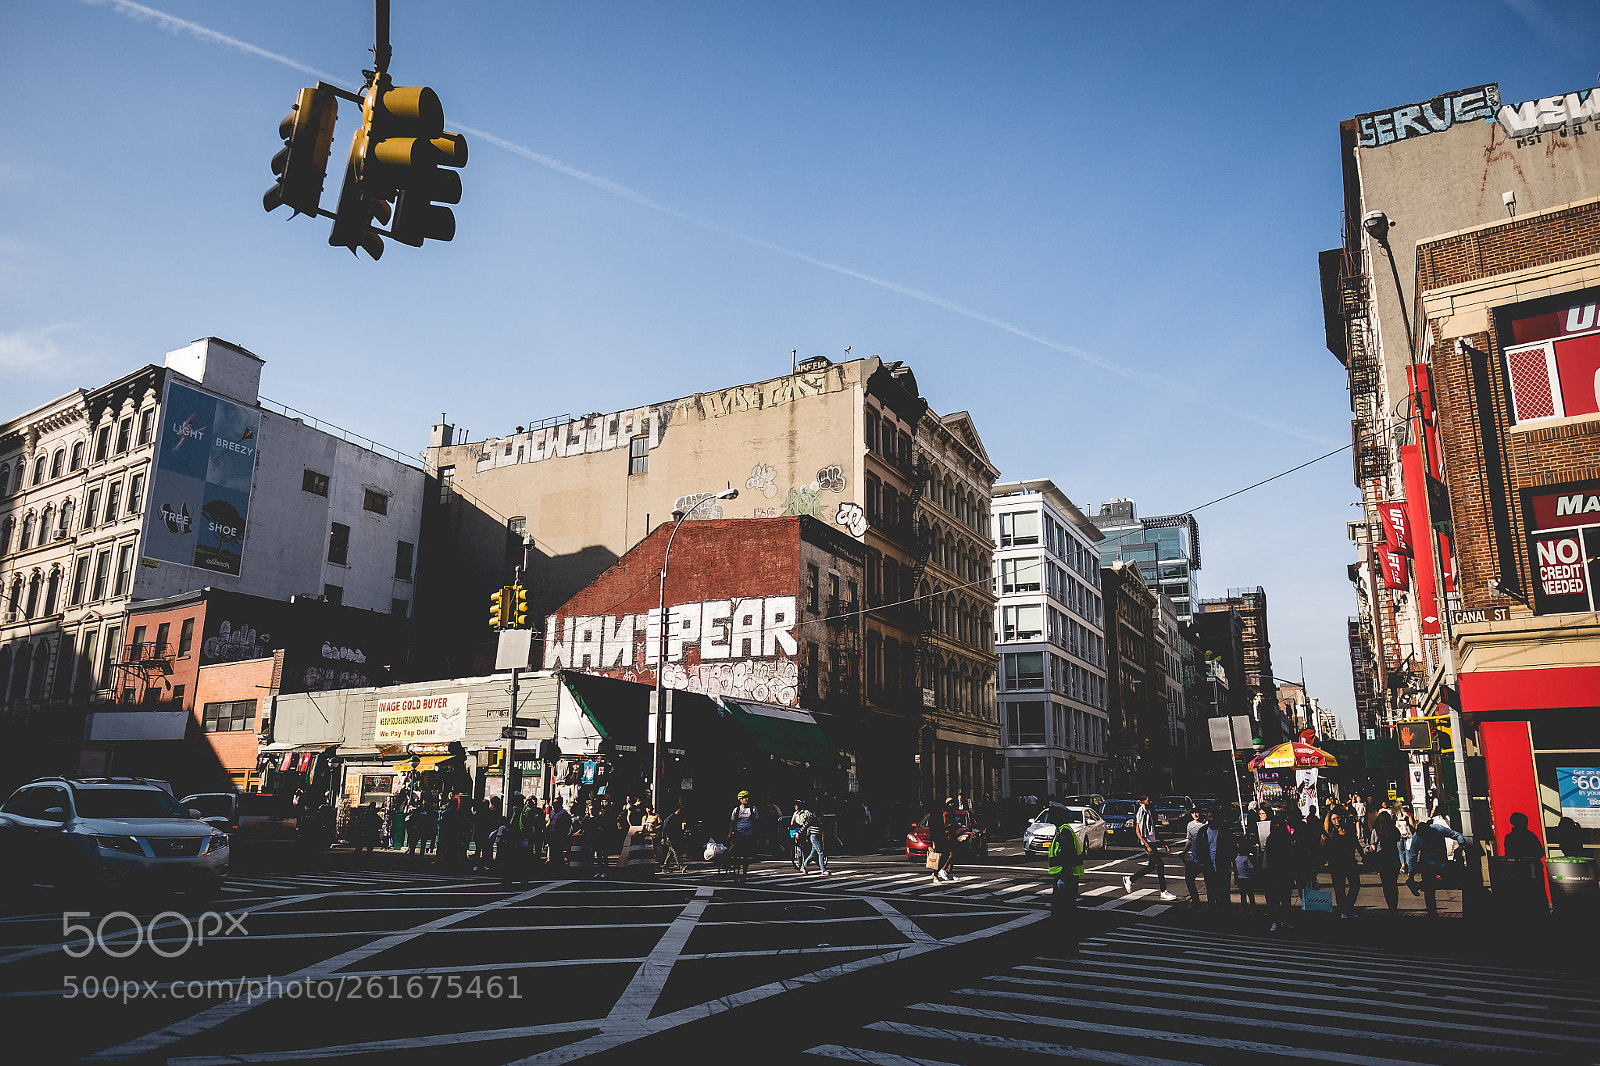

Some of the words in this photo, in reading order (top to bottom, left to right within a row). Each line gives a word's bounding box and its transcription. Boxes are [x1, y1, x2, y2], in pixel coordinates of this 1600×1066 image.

[1358, 91, 1493, 148] SERVE
[1566, 302, 1600, 332] U
[172, 422, 205, 441] LIGHT
[215, 437, 254, 456] BREEZY
[1556, 493, 1600, 516] MA
[162, 510, 189, 525] TREE
[208, 522, 238, 537] SHOE
[1536, 538, 1579, 566] NO
[1539, 563, 1581, 581] CREDIT
[1455, 610, 1490, 624] CANAL
[1494, 608, 1507, 621] ST
[401, 699, 421, 711] GOLD
[422, 697, 448, 710] BUYER
[380, 730, 389, 738] We
[390, 730, 402, 738] Pay
[403, 729, 415, 737] Top
[416, 728, 436, 736] Dollar
